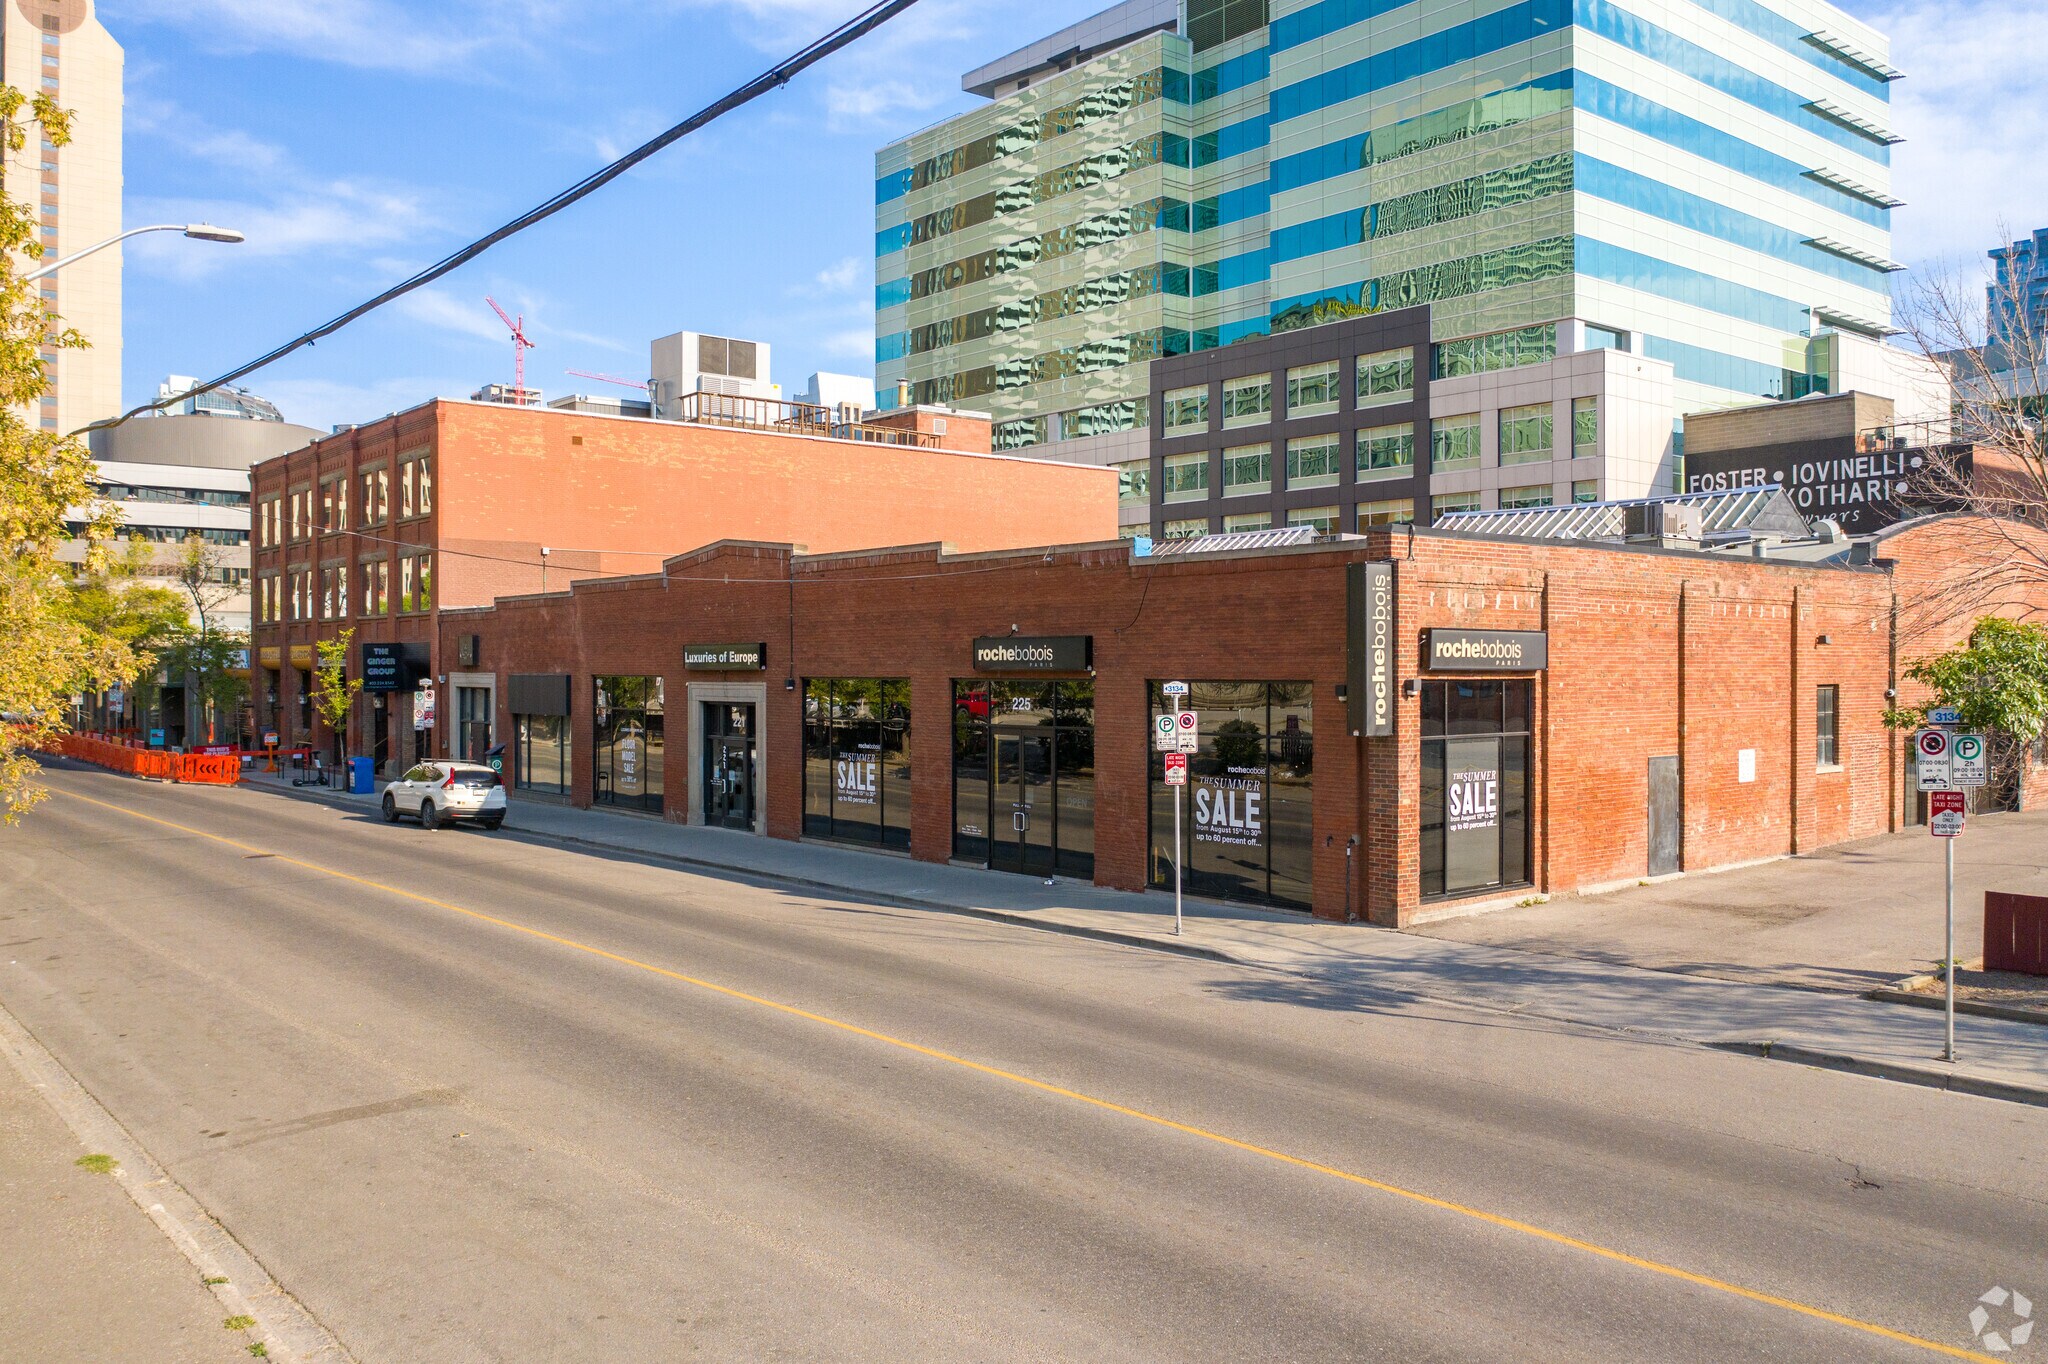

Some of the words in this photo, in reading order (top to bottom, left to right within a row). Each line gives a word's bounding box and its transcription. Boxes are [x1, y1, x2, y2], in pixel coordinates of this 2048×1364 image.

[1690, 468, 1767, 494] FOSTER
[1792, 453, 1904, 485] IOVINELLI
[978, 644, 1053, 661] rochebobois
[1372, 574, 1386, 725] rochebobois
[1436, 638, 1521, 658] rochebobois
[684, 652, 717, 663] Luxuries
[719, 651, 727, 662] of
[729, 651, 758, 665] Europe
[1012, 697, 1031, 711] 225
[733, 718, 745, 728] 221
[1935, 712, 1962, 722] 3134
[847, 752, 876, 762] SUMMER
[838, 760, 876, 791] SALE
[1453, 772, 1463, 780] THE
[1463, 770, 1497, 782] SUMMER
[1213, 778, 1260, 791] SUMMER
[1066, 797, 1088, 808] OPEN
[1450, 780, 1497, 816] SALE
[1196, 787, 1260, 829] SALE
[1210, 825, 1231, 833] August
[1469, 821, 1487, 829] percent
[1196, 834, 1204, 842] up
[1213, 834, 1221, 842] 60
[1222, 836, 1247, 845] percent
